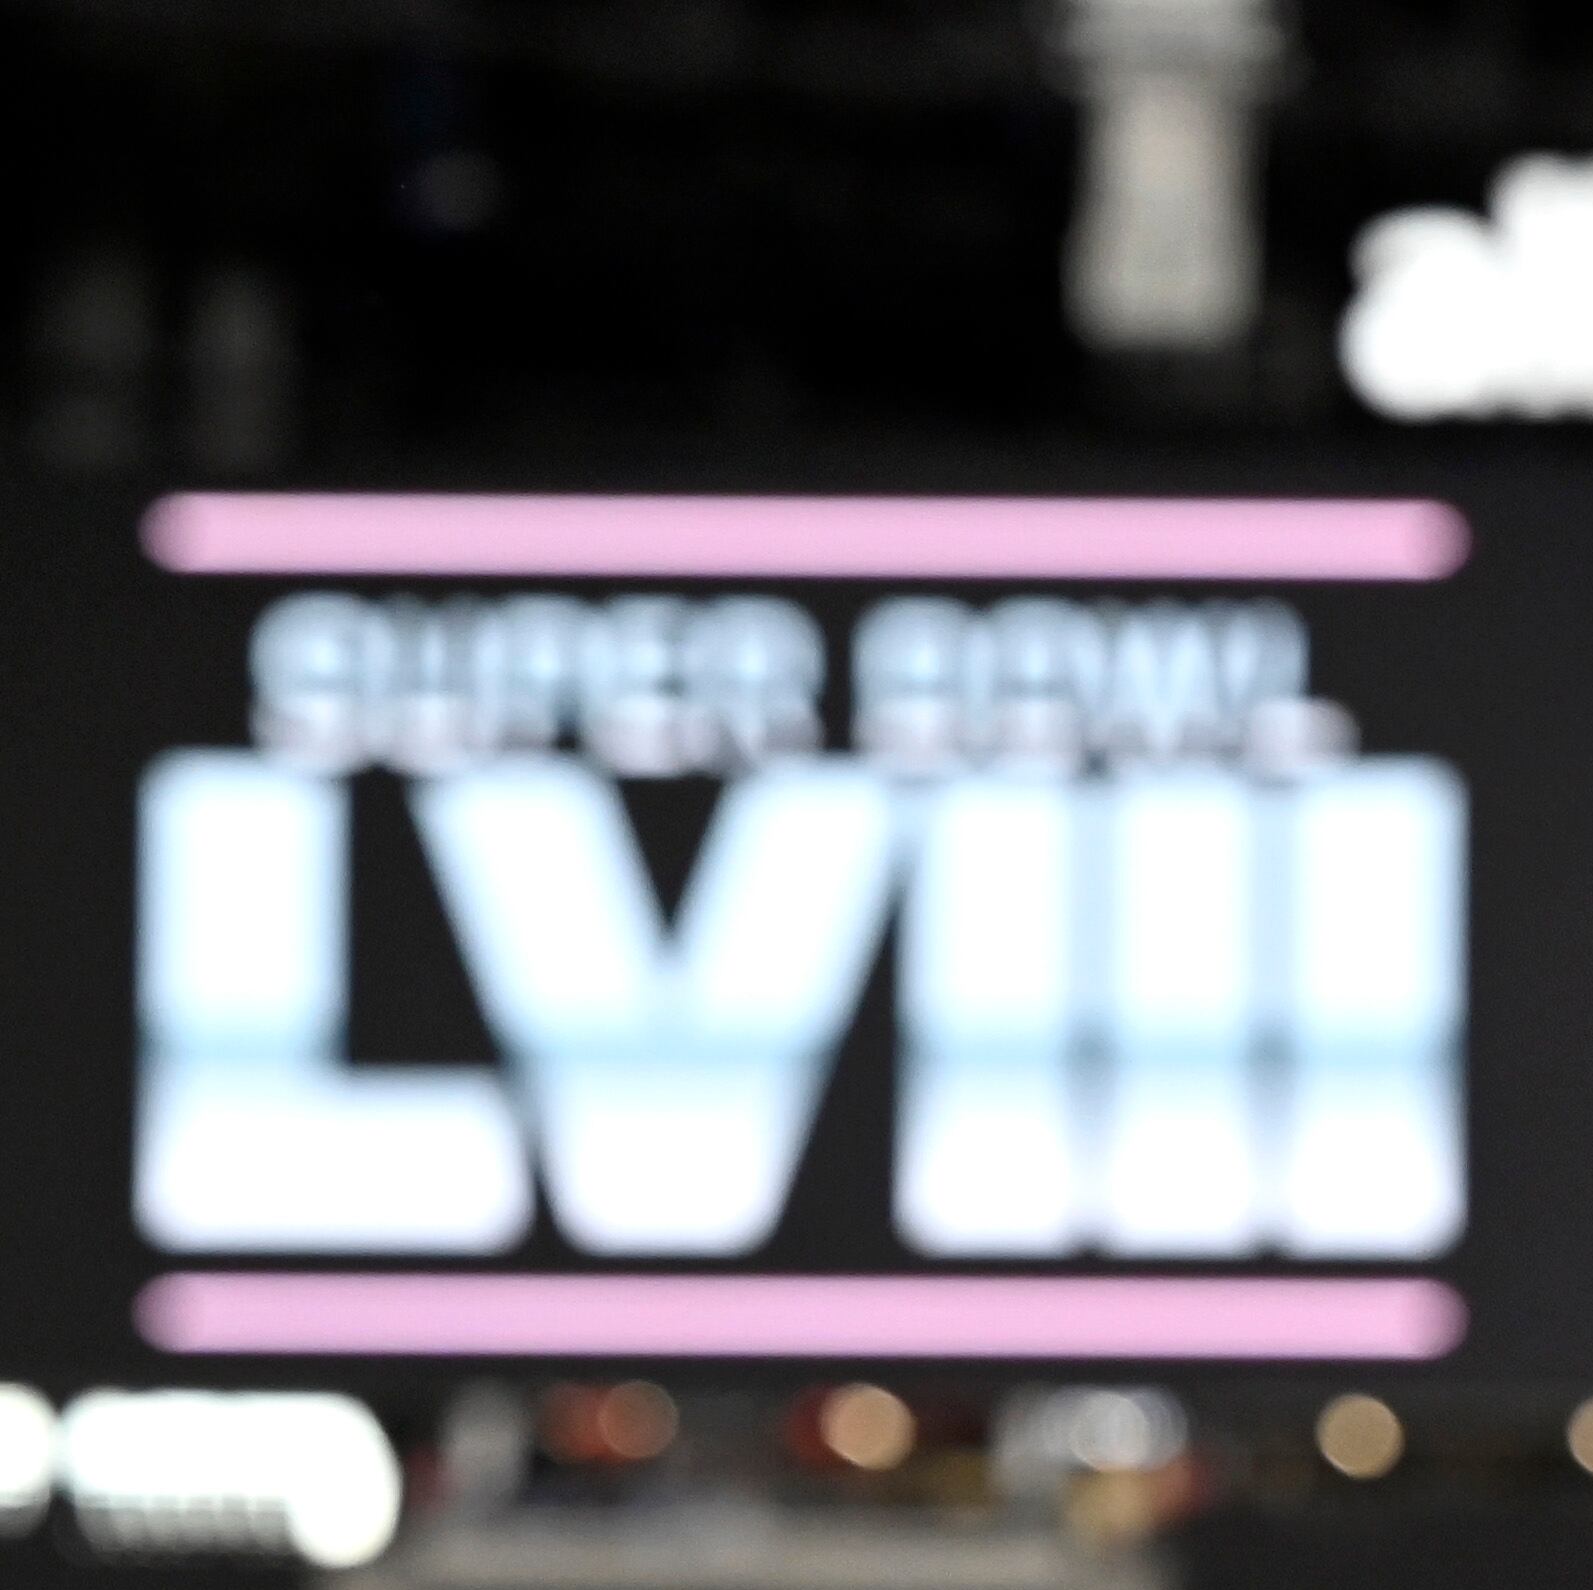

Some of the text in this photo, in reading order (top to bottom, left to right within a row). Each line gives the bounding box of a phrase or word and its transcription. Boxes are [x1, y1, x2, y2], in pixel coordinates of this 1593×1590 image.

[250, 592, 1360, 776] SUPER BOWL
[136, 748, 1470, 1260] LVIII
